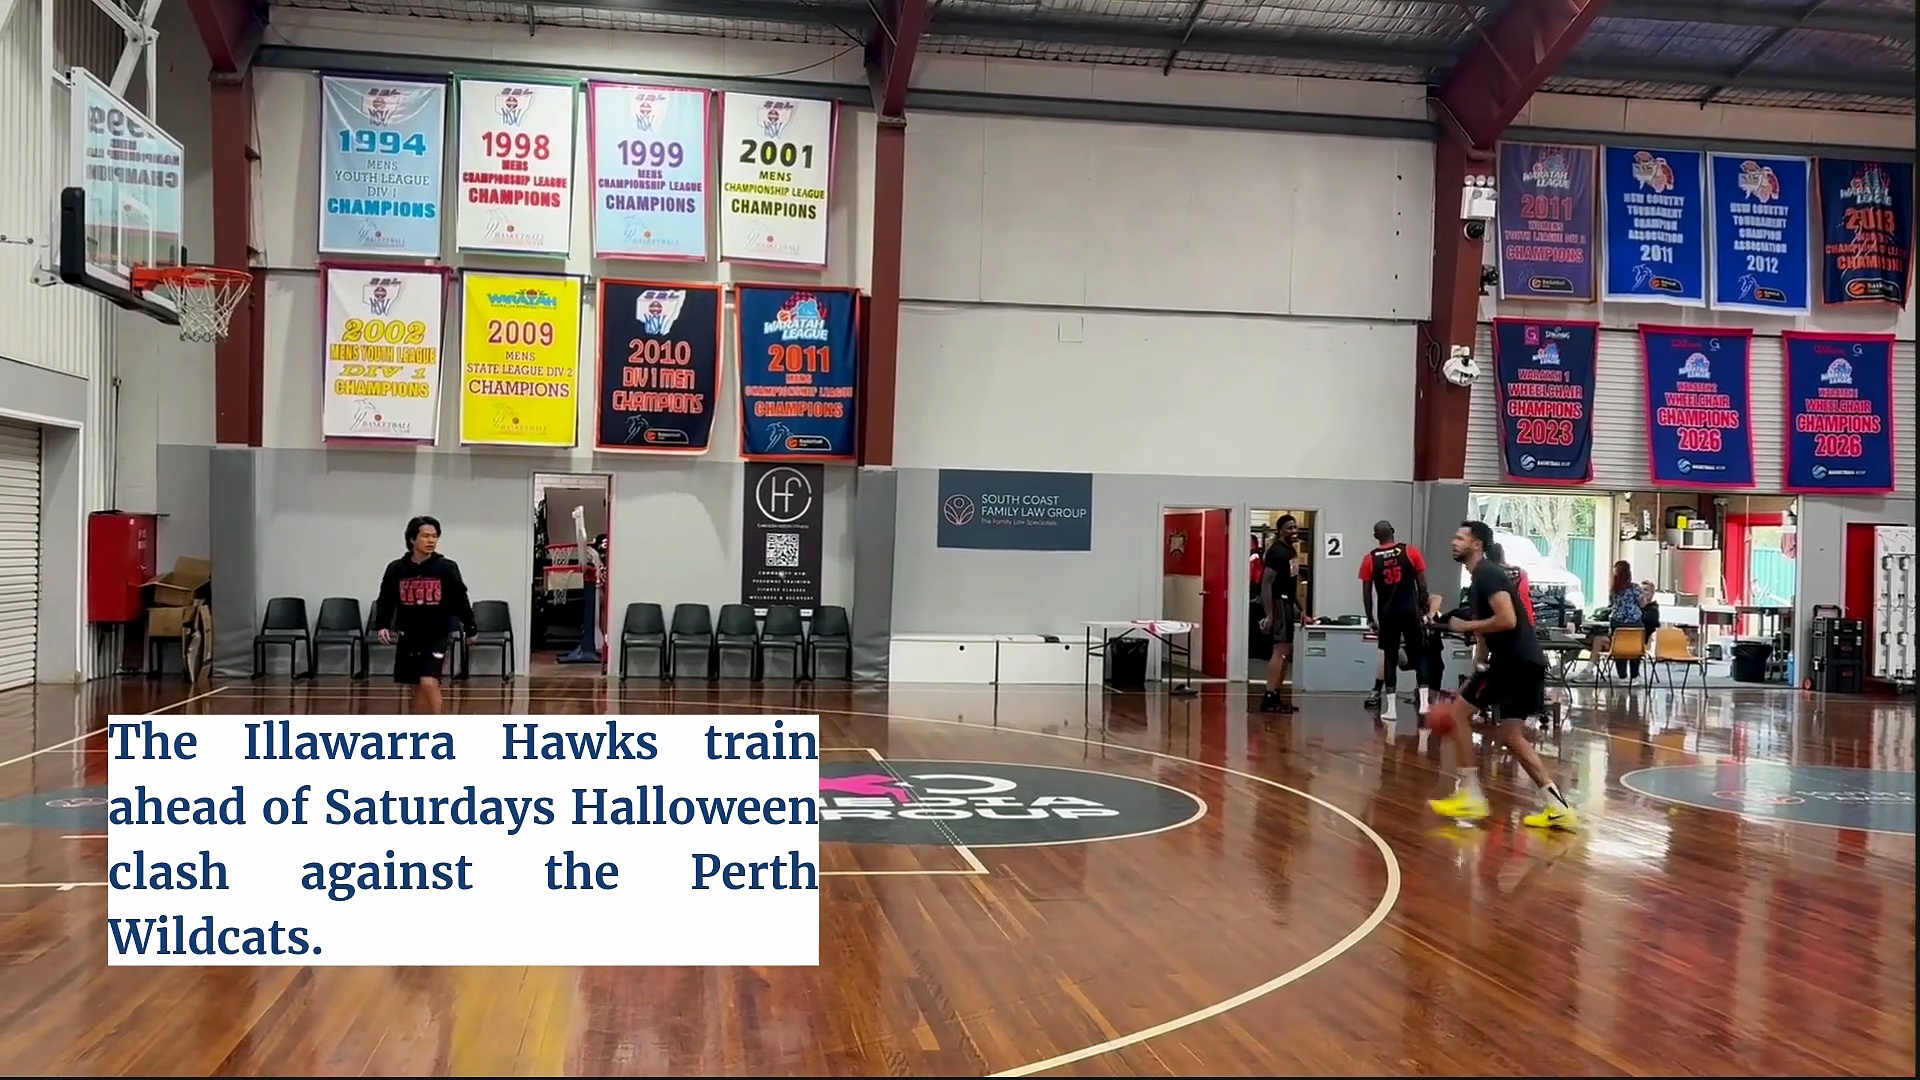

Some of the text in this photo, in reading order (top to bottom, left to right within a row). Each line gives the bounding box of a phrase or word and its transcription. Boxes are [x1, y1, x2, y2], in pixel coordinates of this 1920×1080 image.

[339, 129, 426, 155] 1994
[481, 131, 550, 160] 1998
[617, 140, 684, 168] 1999
[740, 139, 813, 168] 2001
[367, 160, 398, 171] MENS
[638, 169, 663, 179] MENS
[334, 170, 430, 186] YOUTH LEAGUE
[462, 172, 567, 188] CHAMPIONSHIP LEAGUE
[598, 178, 702, 192] CHAMPIONSHIP LEAGUE
[759, 170, 792, 182] MENS
[1522, 171, 1568, 183] WARATAH
[1536, 178, 1571, 189] LEAGUE
[367, 186, 389, 198] DIV
[468, 188, 560, 208] CHAMPIONS
[724, 183, 825, 199] CHAMPIONSHIP LEAGUE
[327, 198, 436, 219] CHAMPIONS
[606, 194, 695, 213] CHAMPIONS
[731, 199, 817, 219] CHAMPIONS
[1520, 194, 1573, 220] 2011
[1845, 208, 1895, 232] 2013
[1628, 230, 1683, 244] ASSOCIATION
[1506, 244, 1584, 263] CHAMPIONS
[1640, 244, 1673, 264] 2011
[1746, 255, 1779, 274] 2012
[342, 318, 426, 344] 2002
[488, 320, 554, 346] 2009
[763, 319, 825, 334] WARATAH
[781, 328, 829, 341] LEAGUE
[330, 344, 436, 364] MENS YOUTH LEAGUE
[505, 351, 536, 362] MENS
[628, 339, 692, 365] 2010
[768, 345, 830, 372] 2011
[340, 365, 426, 379] DIV 1
[467, 363, 573, 378] STATE LEAGUE DIV 2
[623, 367, 648, 387] DIV
[650, 370, 657, 388] 1
[1564, 371, 1570, 382] 1
[334, 380, 429, 398] CHAMPIONS
[468, 379, 570, 398] CHAMPIONS
[1508, 383, 1583, 398] WHEELCHAIR
[612, 391, 704, 414] CHAMPIONS
[1664, 392, 1730, 408] WHEELCHAIR
[1805, 398, 1872, 413] WHEELCHAIR
[754, 401, 843, 418] CHAMPIONS
[1508, 401, 1583, 419] CHAMPIONS
[1656, 407, 1739, 428] CHAMPIONS
[1796, 413, 1881, 433] CHAMPIONS
[1516, 419, 1574, 446] 2023
[1677, 427, 1722, 452] 2026
[1814, 434, 1862, 457] 2026
[981, 494, 1059, 506] SOUTH COAST
[981, 506, 1087, 518] FAMILY LAW GROUP
[993, 518, 1011, 526] Family
[1327, 538, 1341, 556] 2
[819, 796, 1105, 807] EDIA
[821, 808, 1120, 820] ROUP
